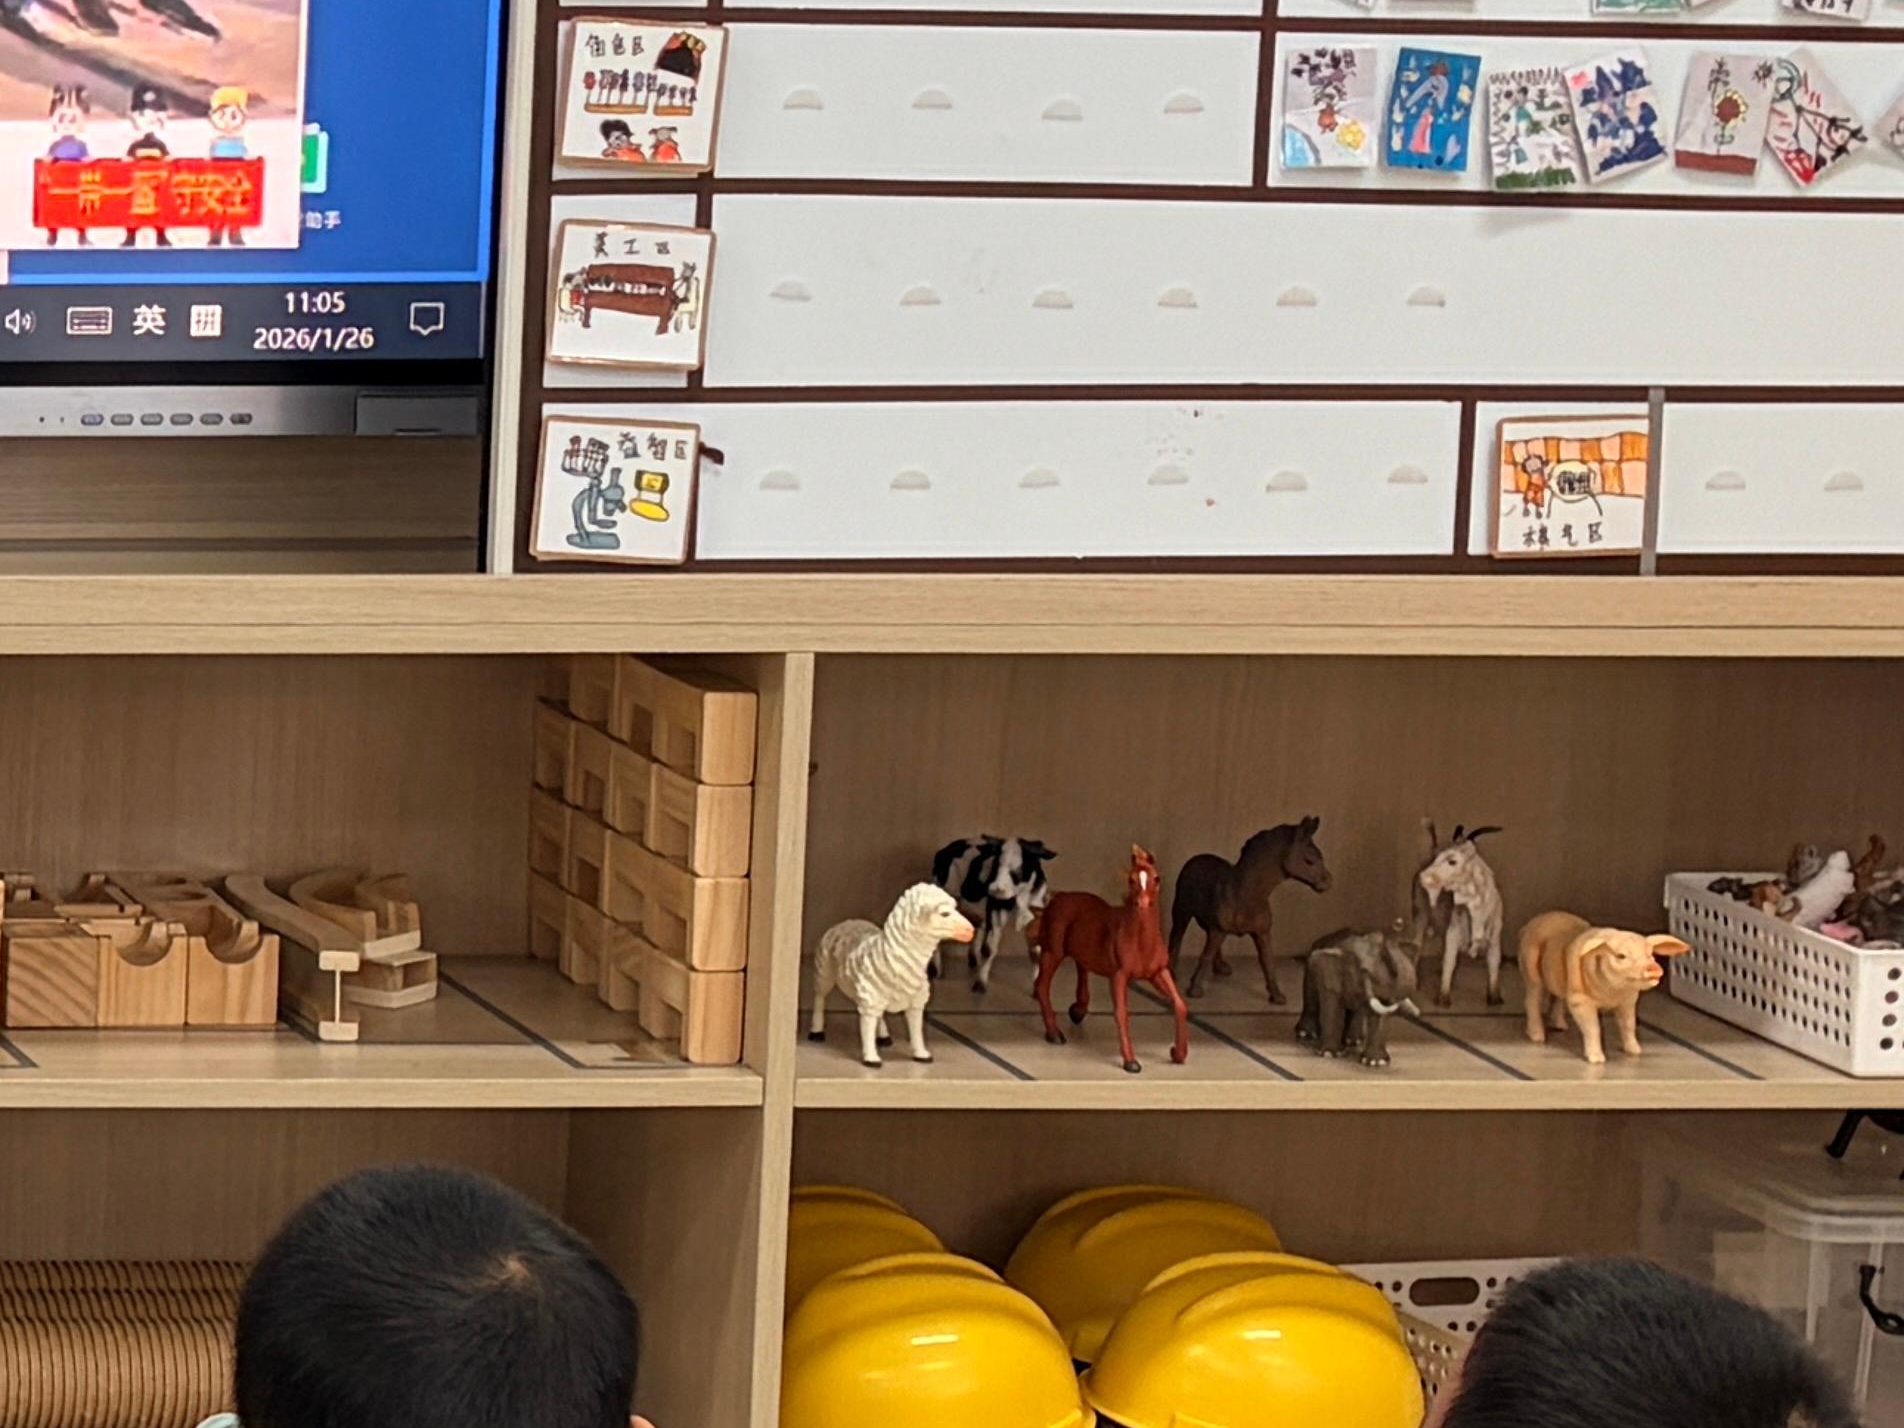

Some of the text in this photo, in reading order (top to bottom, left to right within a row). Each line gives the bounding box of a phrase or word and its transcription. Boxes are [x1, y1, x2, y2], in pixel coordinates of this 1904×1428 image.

[285, 291, 345, 314] 11:05
[133, 304, 167, 336] 英
[253, 327, 375, 352] 2026/1/26
